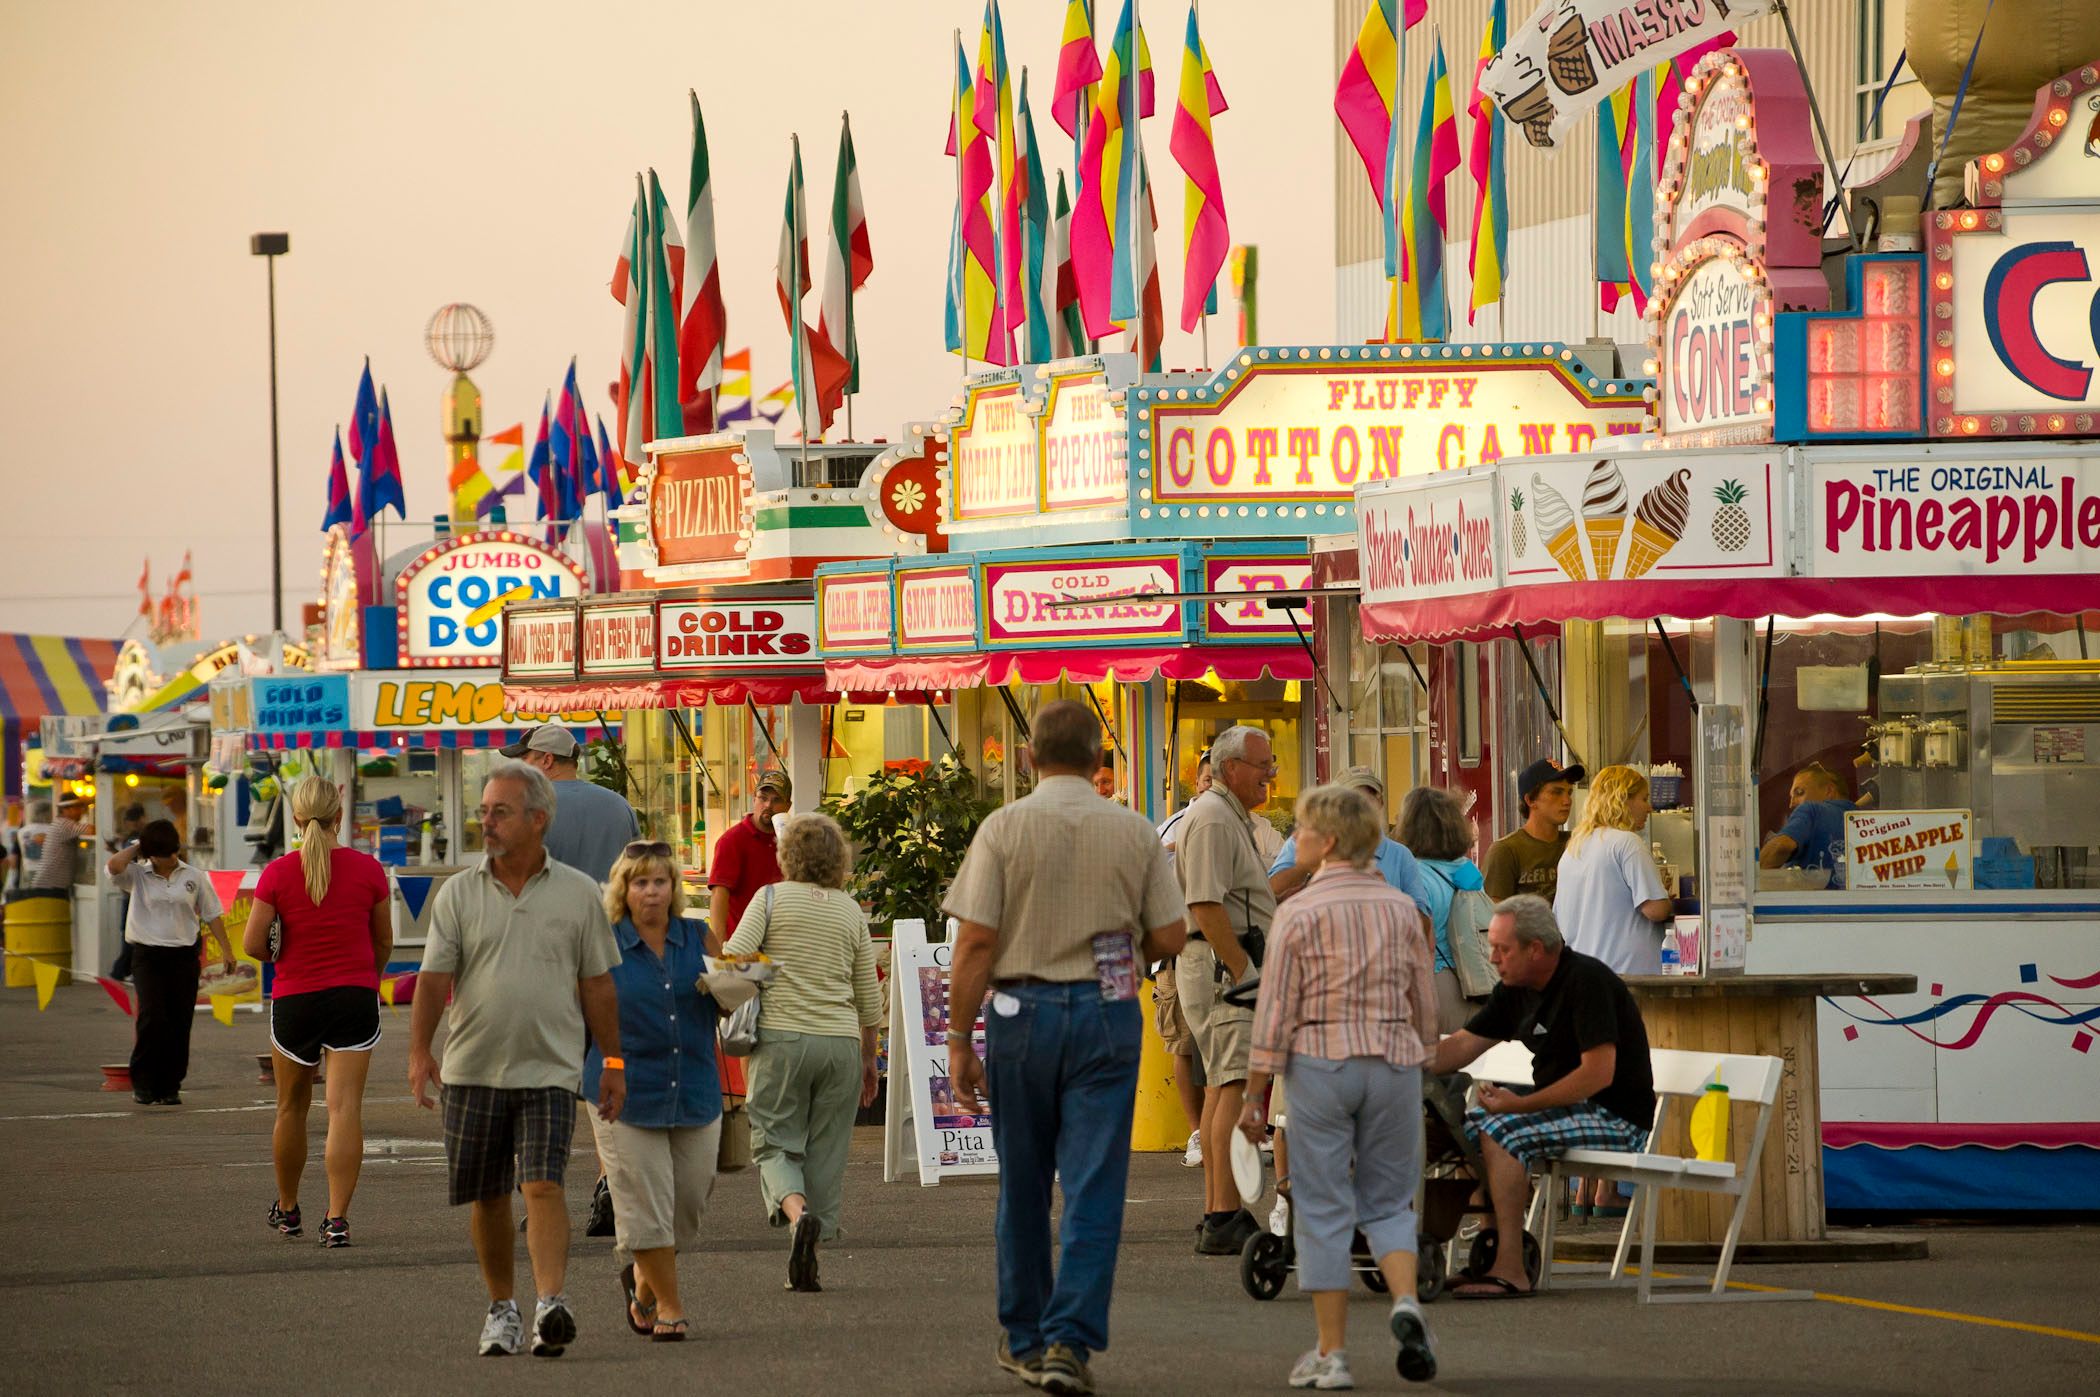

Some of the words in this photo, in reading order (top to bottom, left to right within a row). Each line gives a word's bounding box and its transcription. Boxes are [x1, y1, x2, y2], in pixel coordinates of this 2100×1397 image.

[1690, 275, 1714, 321] Soft
[1715, 274, 1749, 317] Serve
[1984, 241, 2100, 401] C
[1327, 377, 1479, 411] FLUFFY
[985, 401, 1017, 433] FLUFFY
[1168, 424, 1404, 488] COTTON
[961, 445, 1001, 505] COTTON
[1872, 467, 1921, 493] THE
[1930, 465, 2054, 491] ORIGINAL
[1825, 476, 2100, 564] Pineapple
[442, 551, 542, 571] JUMBO
[1365, 508, 1405, 592] Shakes
[1408, 501, 1455, 588] Sundaes
[1458, 497, 1493, 582] Cones
[1051, 574, 1110, 589] COLD
[1237, 573, 1312, 620] P
[678, 610, 784, 634] COLD
[906, 586, 937, 632] SNOW
[940, 582, 974, 629] CONES
[429, 616, 498, 648] DO
[529, 622, 555, 665] TOSSED
[585, 617, 605, 662] OVEN
[607, 616, 632, 660] FRESH
[667, 633, 811, 657] DRINKS
[265, 683, 324, 705] COLD
[374, 681, 622, 726] LEMO
[1853, 816, 1876, 829] The
[1859, 816, 1912, 839] Original
[1855, 822, 1965, 865] PINEAPPLE
[1873, 855, 1927, 882] WHIP
[942, 1130, 985, 1151] Pita
